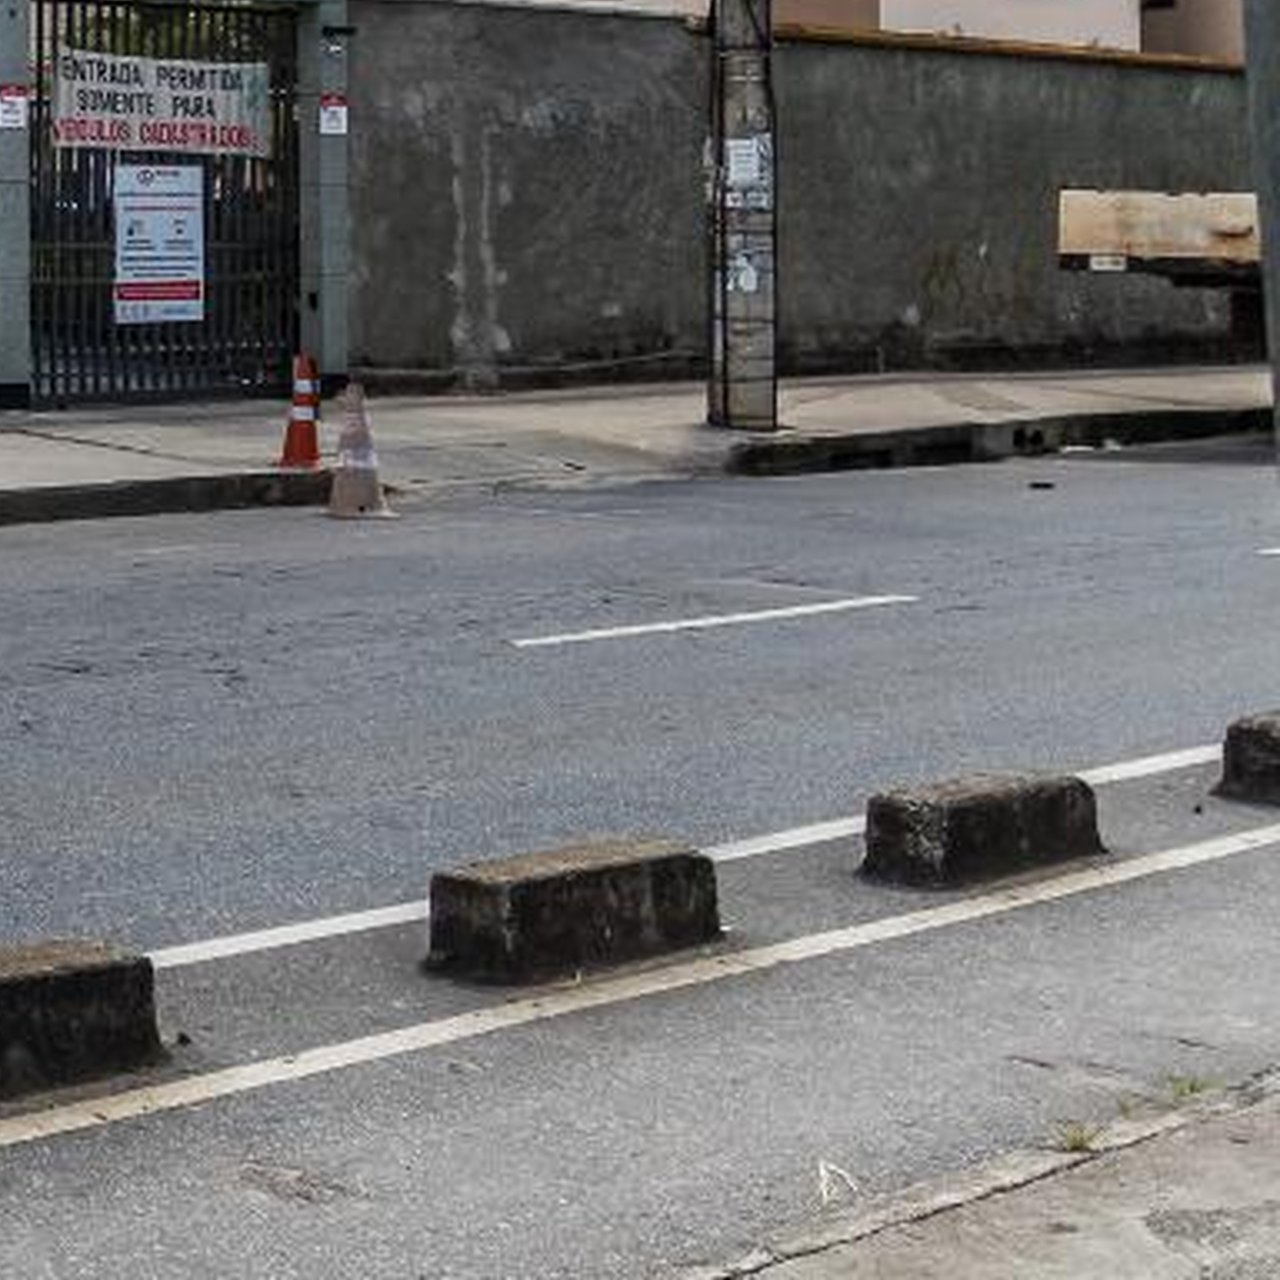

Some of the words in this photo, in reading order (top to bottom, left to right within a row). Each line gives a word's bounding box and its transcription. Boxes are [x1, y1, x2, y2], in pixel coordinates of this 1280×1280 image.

[61, 56, 144, 87] ENTRADA
[77, 89, 155, 116] SOMENTE
[172, 94, 216, 119] PARA
